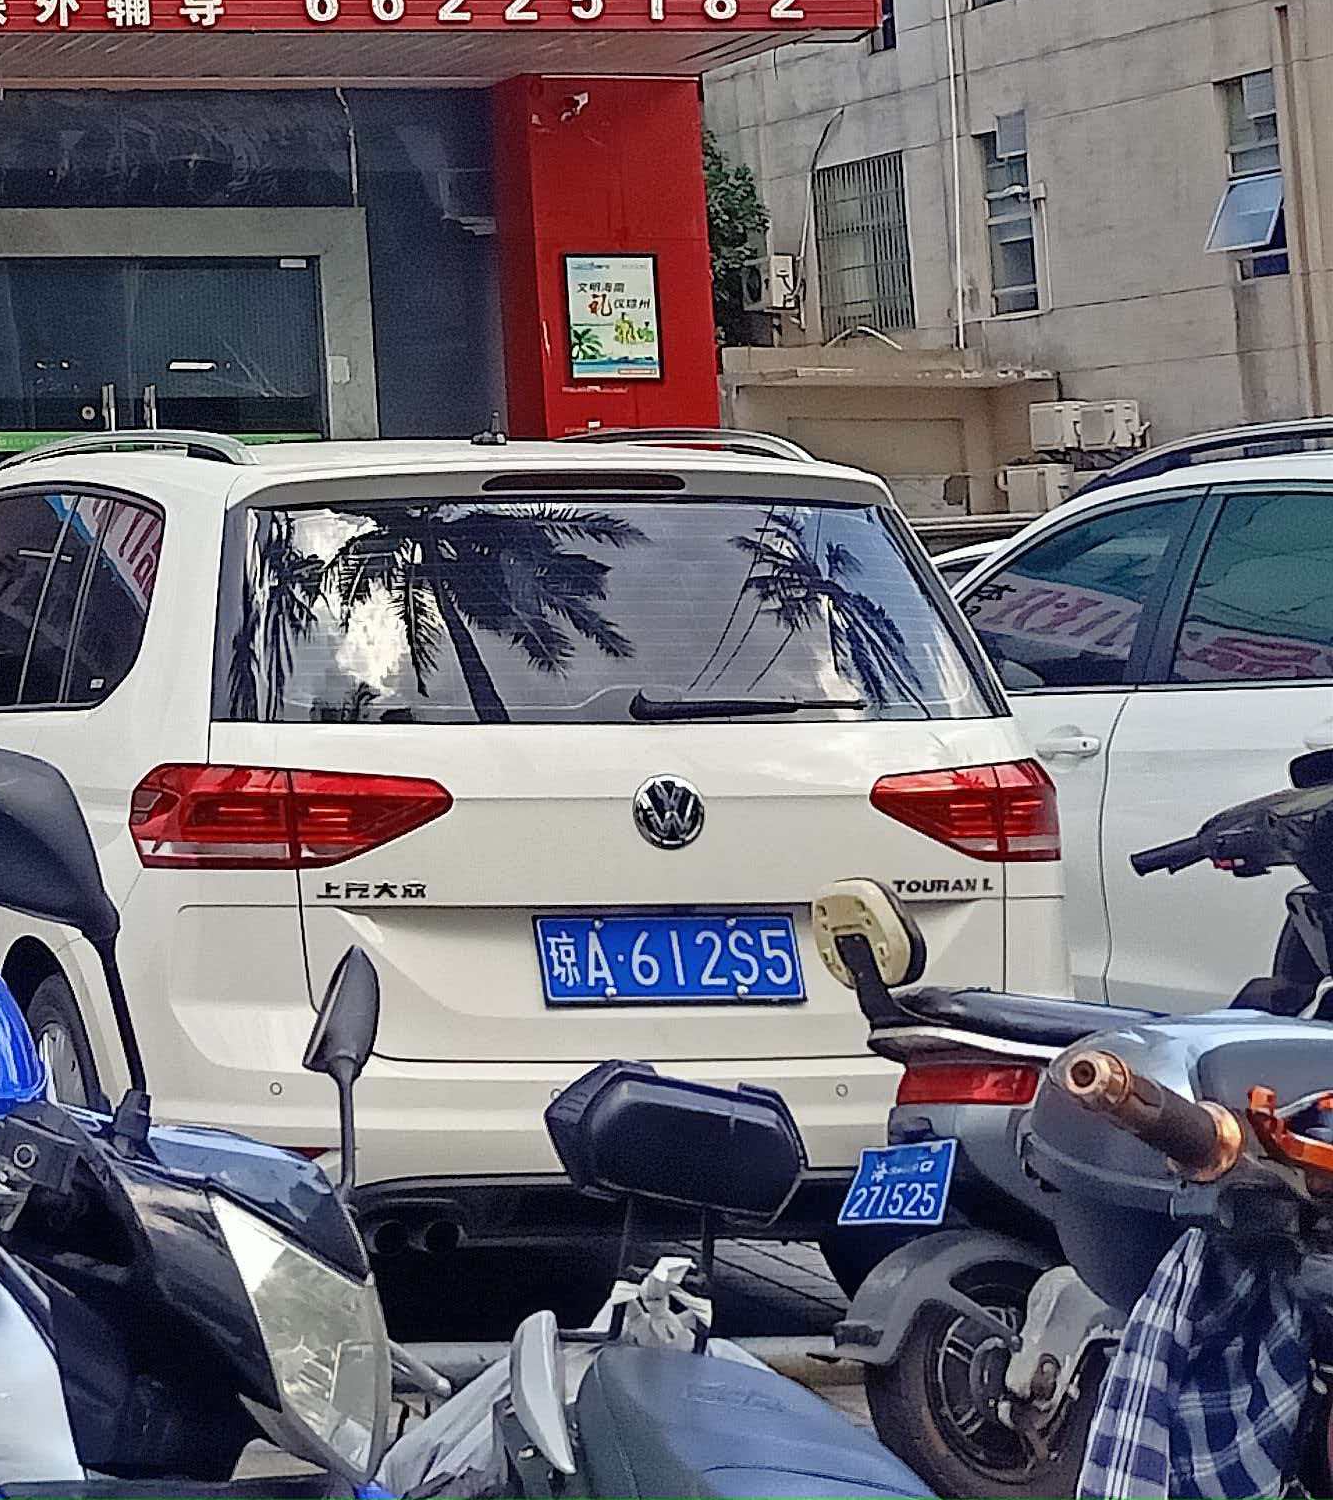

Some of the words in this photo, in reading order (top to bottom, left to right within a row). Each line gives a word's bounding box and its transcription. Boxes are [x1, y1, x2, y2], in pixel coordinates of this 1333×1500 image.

[316, 882, 428, 899] 上汽大众
[893, 878, 978, 894] TOURAN
